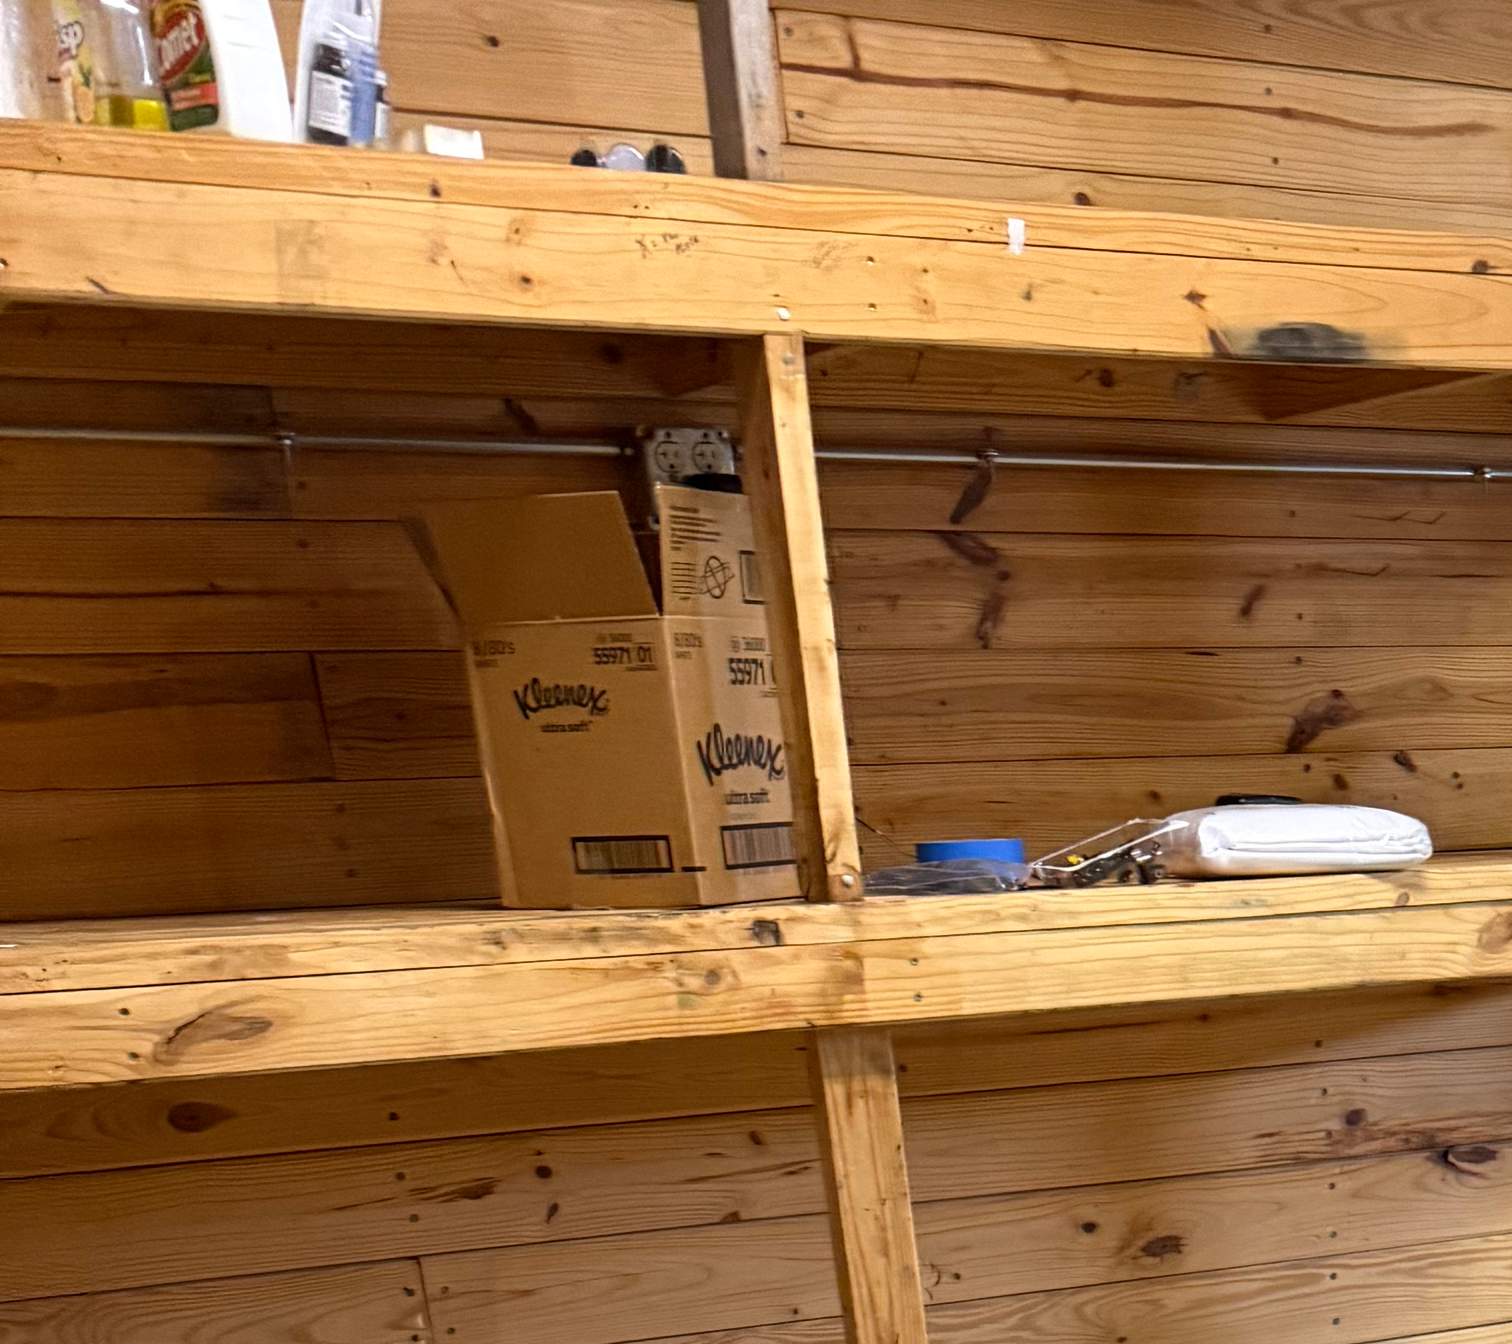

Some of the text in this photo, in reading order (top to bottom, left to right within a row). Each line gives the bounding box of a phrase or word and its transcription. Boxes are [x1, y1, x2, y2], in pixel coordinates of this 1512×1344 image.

[593, 646, 632, 665] 55971
[728, 657, 765, 685] 55971
[513, 677, 609, 720] Kleenex
[696, 722, 784, 787] Kleenex
